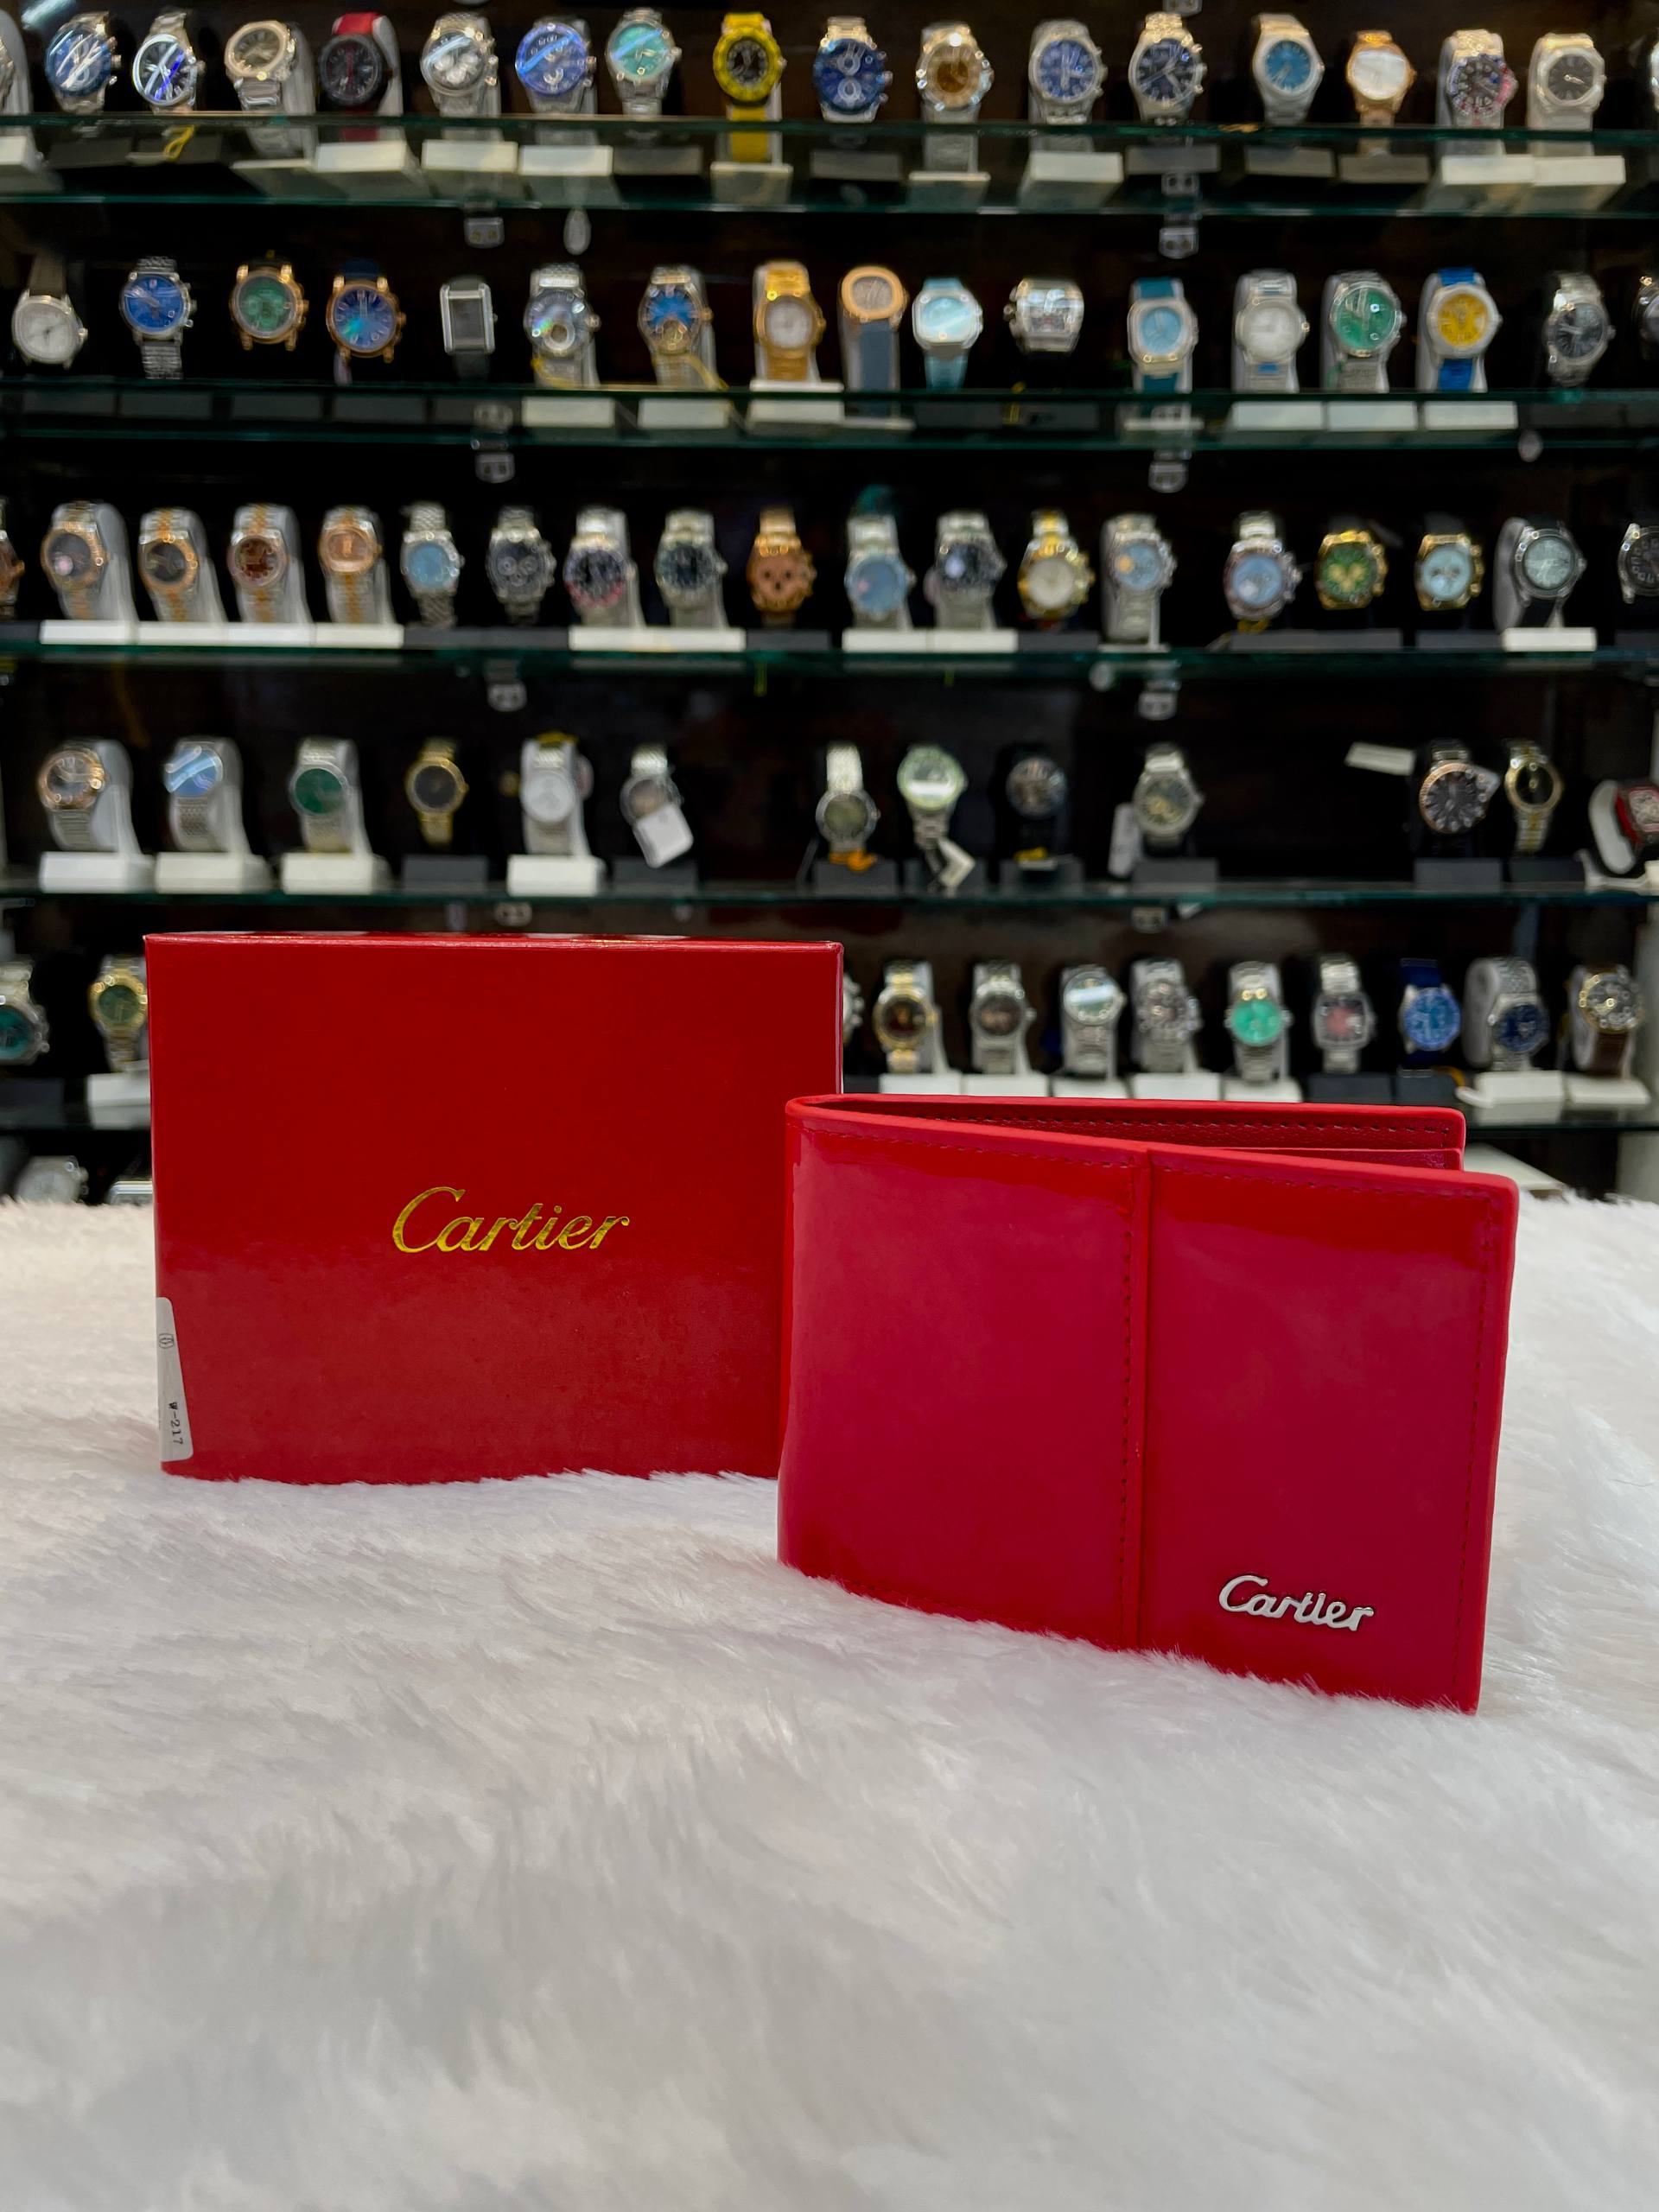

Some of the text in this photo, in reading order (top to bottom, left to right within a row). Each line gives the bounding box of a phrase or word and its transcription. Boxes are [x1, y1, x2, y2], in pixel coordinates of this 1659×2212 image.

[392, 1186, 630, 1253] Cartier
[168, 1402, 184, 1445] W-217
[1218, 1574, 1375, 1631] Cartier
